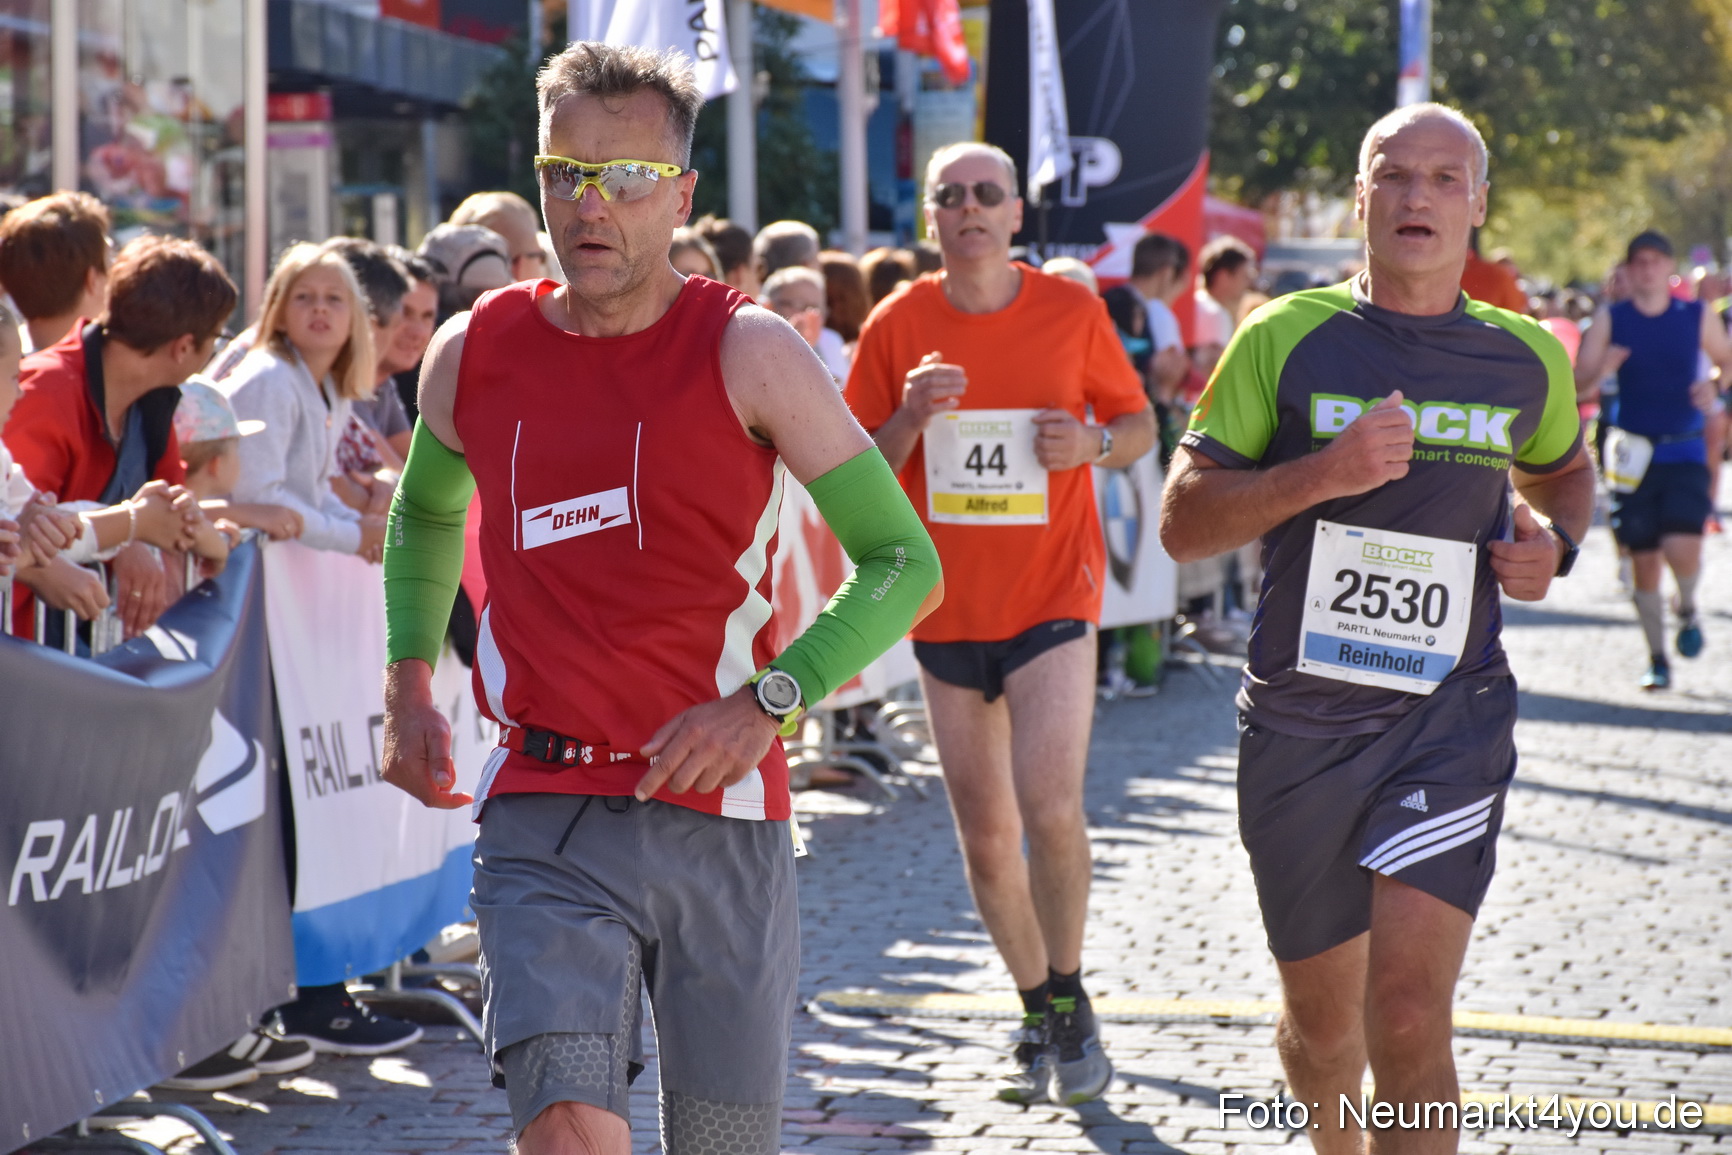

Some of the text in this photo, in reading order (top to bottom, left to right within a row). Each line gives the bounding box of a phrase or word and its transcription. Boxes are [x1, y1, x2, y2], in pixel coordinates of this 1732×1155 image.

[687, 0, 719, 62] PA
[965, 443, 1007, 477] 44
[1411, 449, 1510, 471] mart concepts
[552, 504, 600, 531] DEHN
[965, 498, 1008, 513] Alfred
[1362, 542, 1434, 568] BOCK
[1330, 568, 1450, 629] 2530
[1337, 621, 1422, 644] PARTL Neumarkt
[1338, 643, 1426, 675] Reinhold
